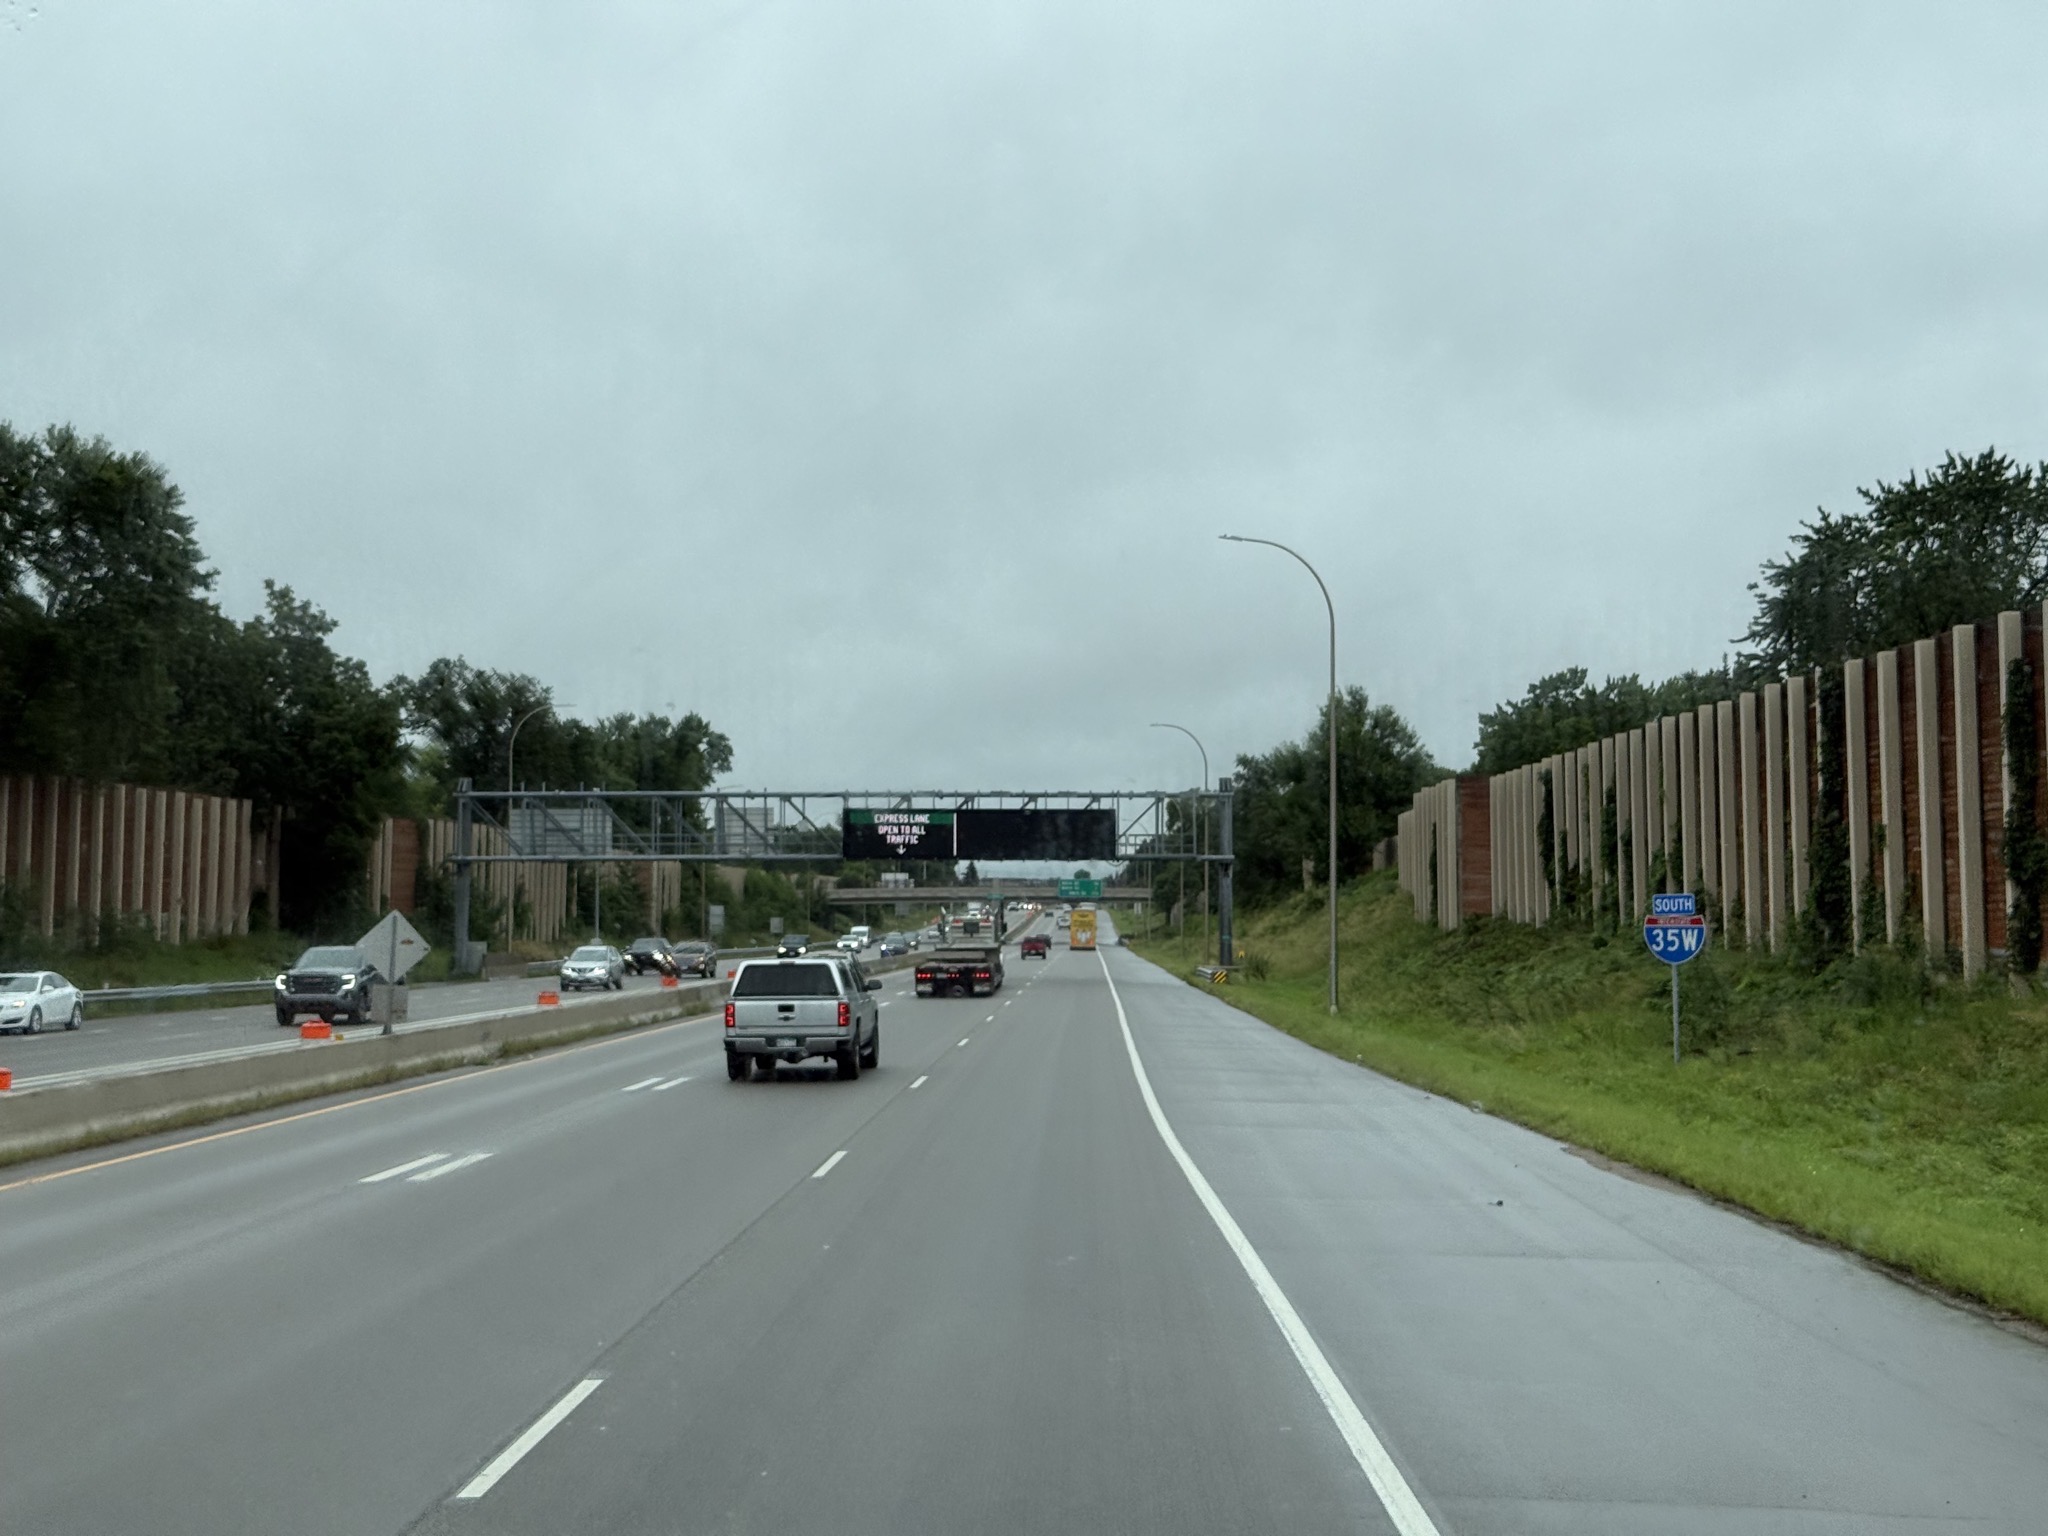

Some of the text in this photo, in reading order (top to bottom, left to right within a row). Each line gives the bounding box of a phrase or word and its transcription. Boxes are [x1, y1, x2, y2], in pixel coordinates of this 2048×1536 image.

[874, 813, 930, 823] EXPRESS LANE
[878, 825, 926, 835] OPEN TO ALL
[886, 835, 919, 844] TRAFFIC
[1655, 898, 1692, 912] SOUTH
[1651, 929, 1698, 952] 35W
